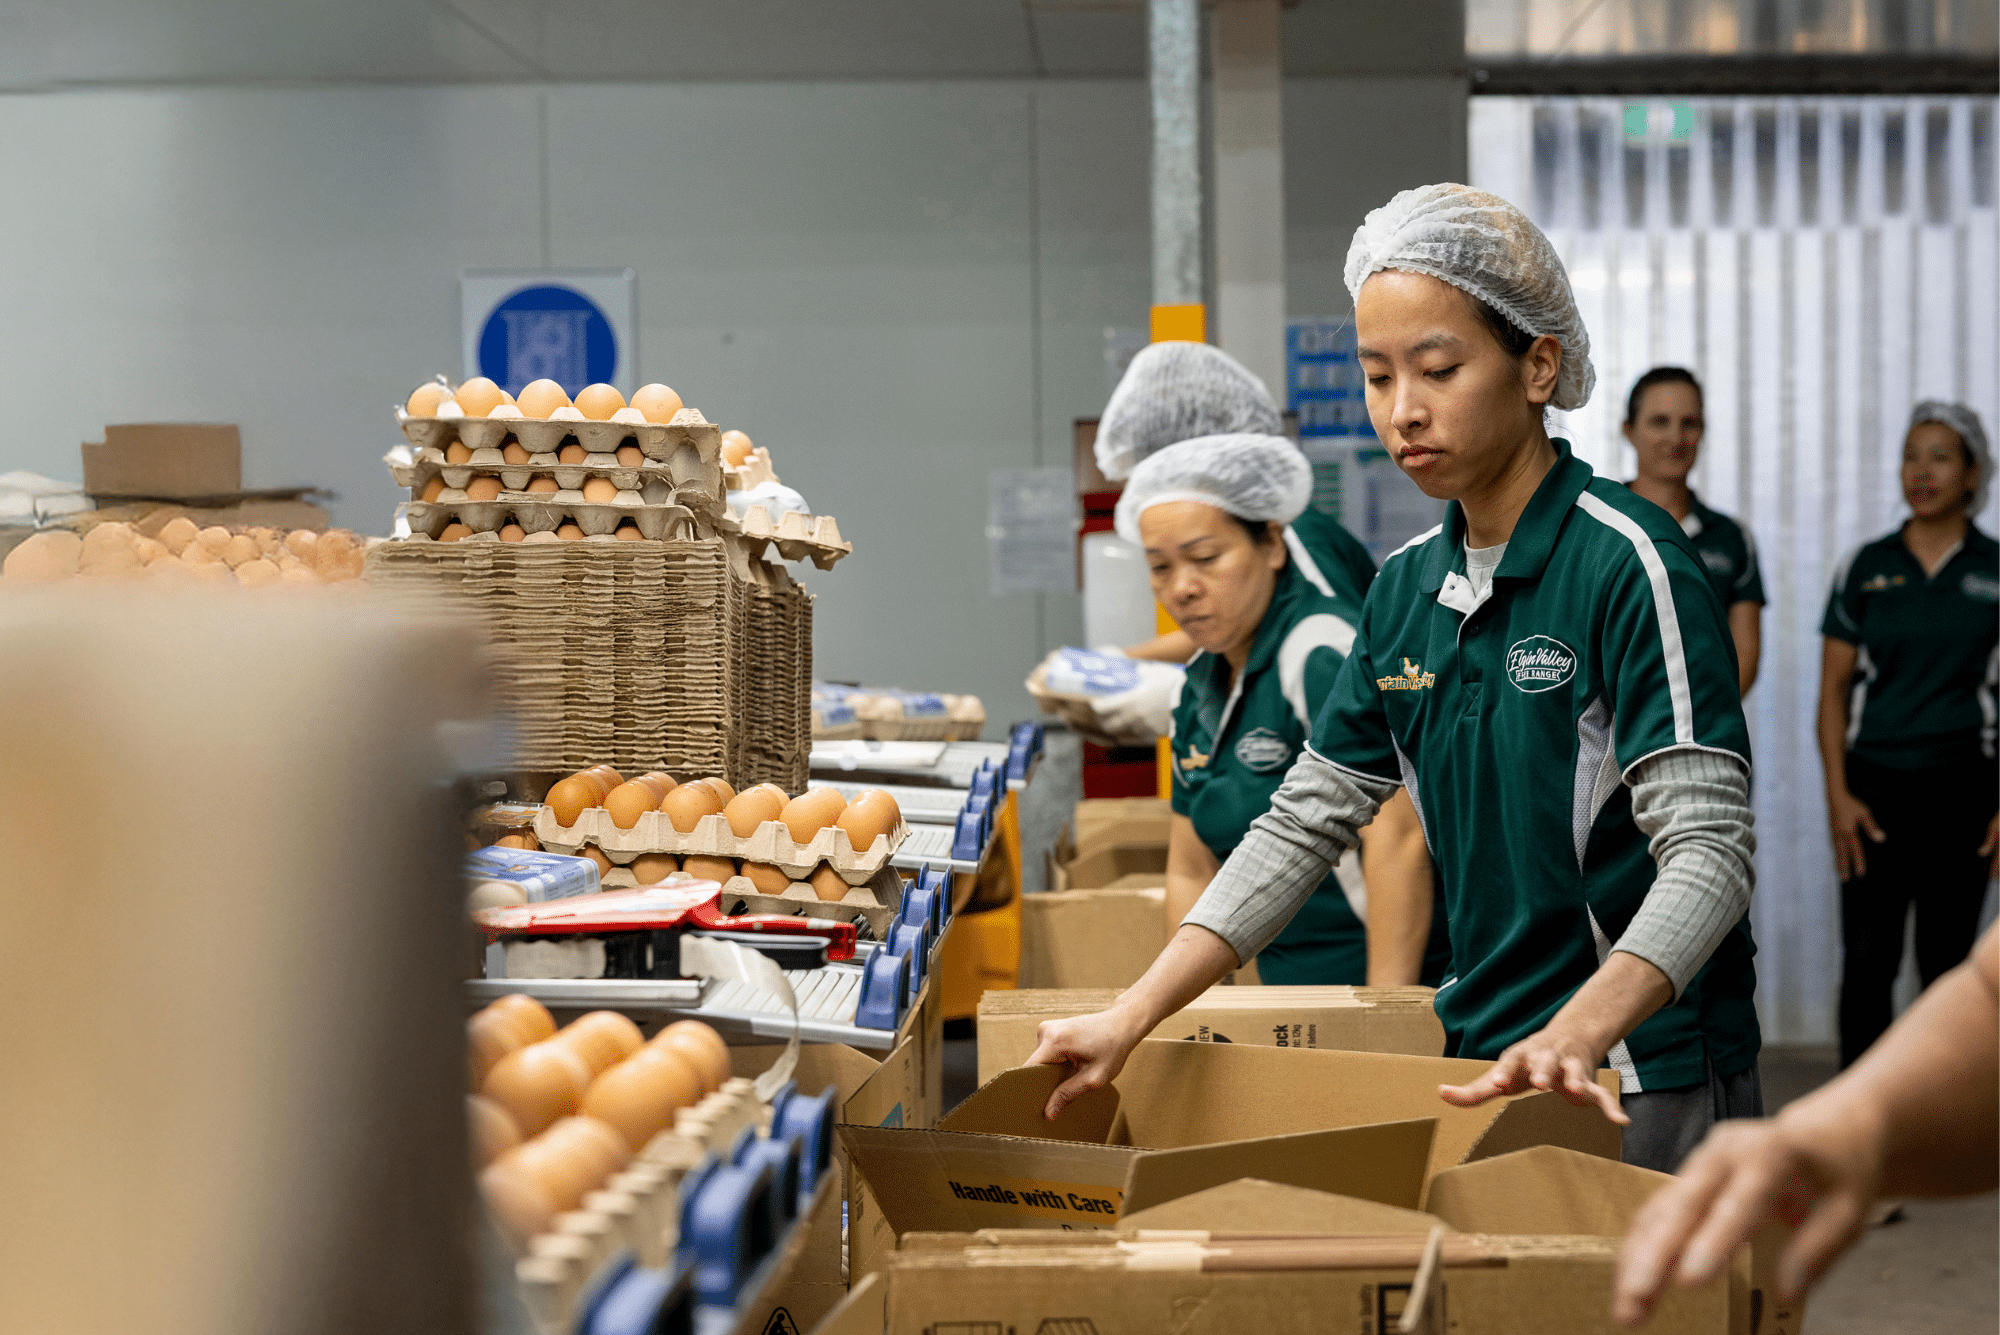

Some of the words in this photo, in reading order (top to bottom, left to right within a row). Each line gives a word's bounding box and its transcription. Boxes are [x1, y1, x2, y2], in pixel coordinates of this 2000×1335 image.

[1509, 649, 1537, 672] Elgin
[1535, 648, 1573, 672] Valley
[1531, 669, 1557, 679] RANGE
[1272, 1024, 1289, 1047] ock
[1292, 1024, 1303, 1038] 12kg
[948, 1181, 1019, 1205] Handle
[1019, 1189, 1067, 1210] with
[1066, 1192, 1116, 1215] Care
